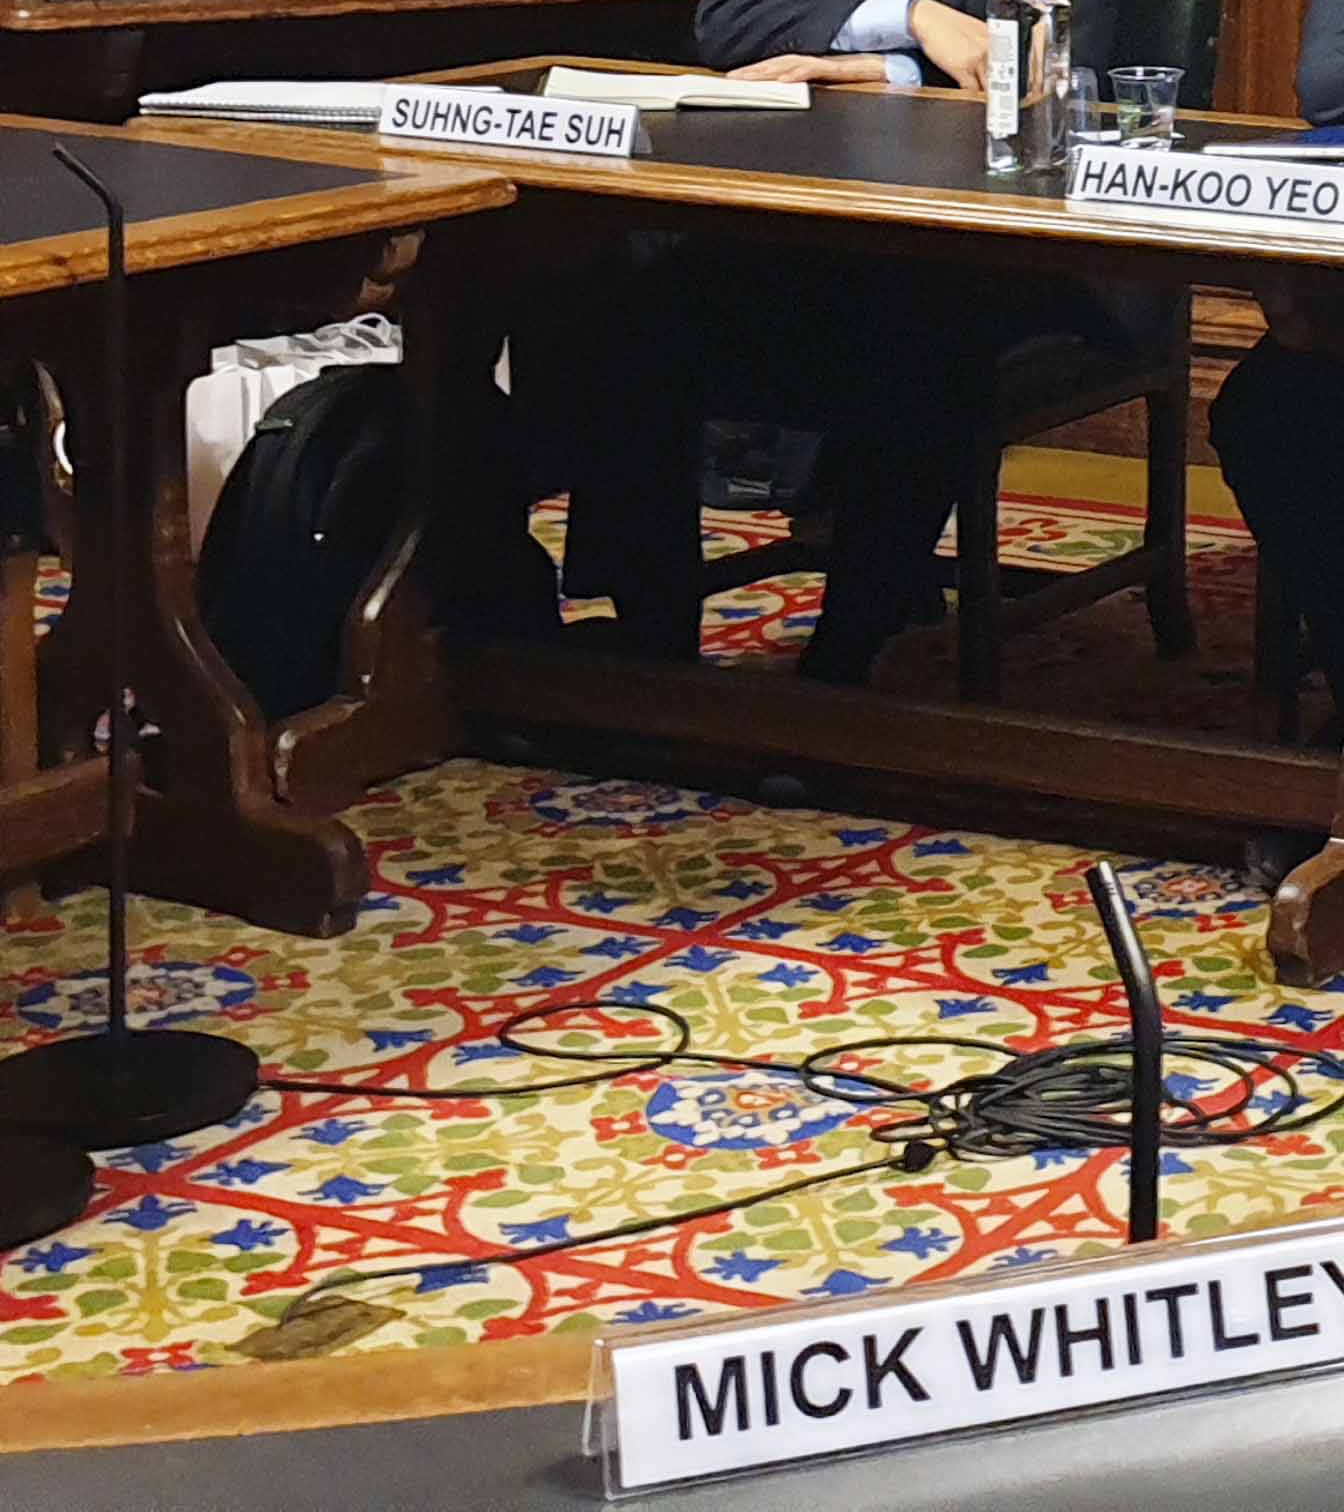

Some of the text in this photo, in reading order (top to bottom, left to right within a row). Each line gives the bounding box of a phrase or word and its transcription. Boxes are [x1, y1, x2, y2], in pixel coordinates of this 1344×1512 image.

[392, 98, 626, 148] SUHNG-TAE SUH
[1081, 160, 1340, 215] HAN-KOO YEO
[674, 1327, 930, 1440] MICK
